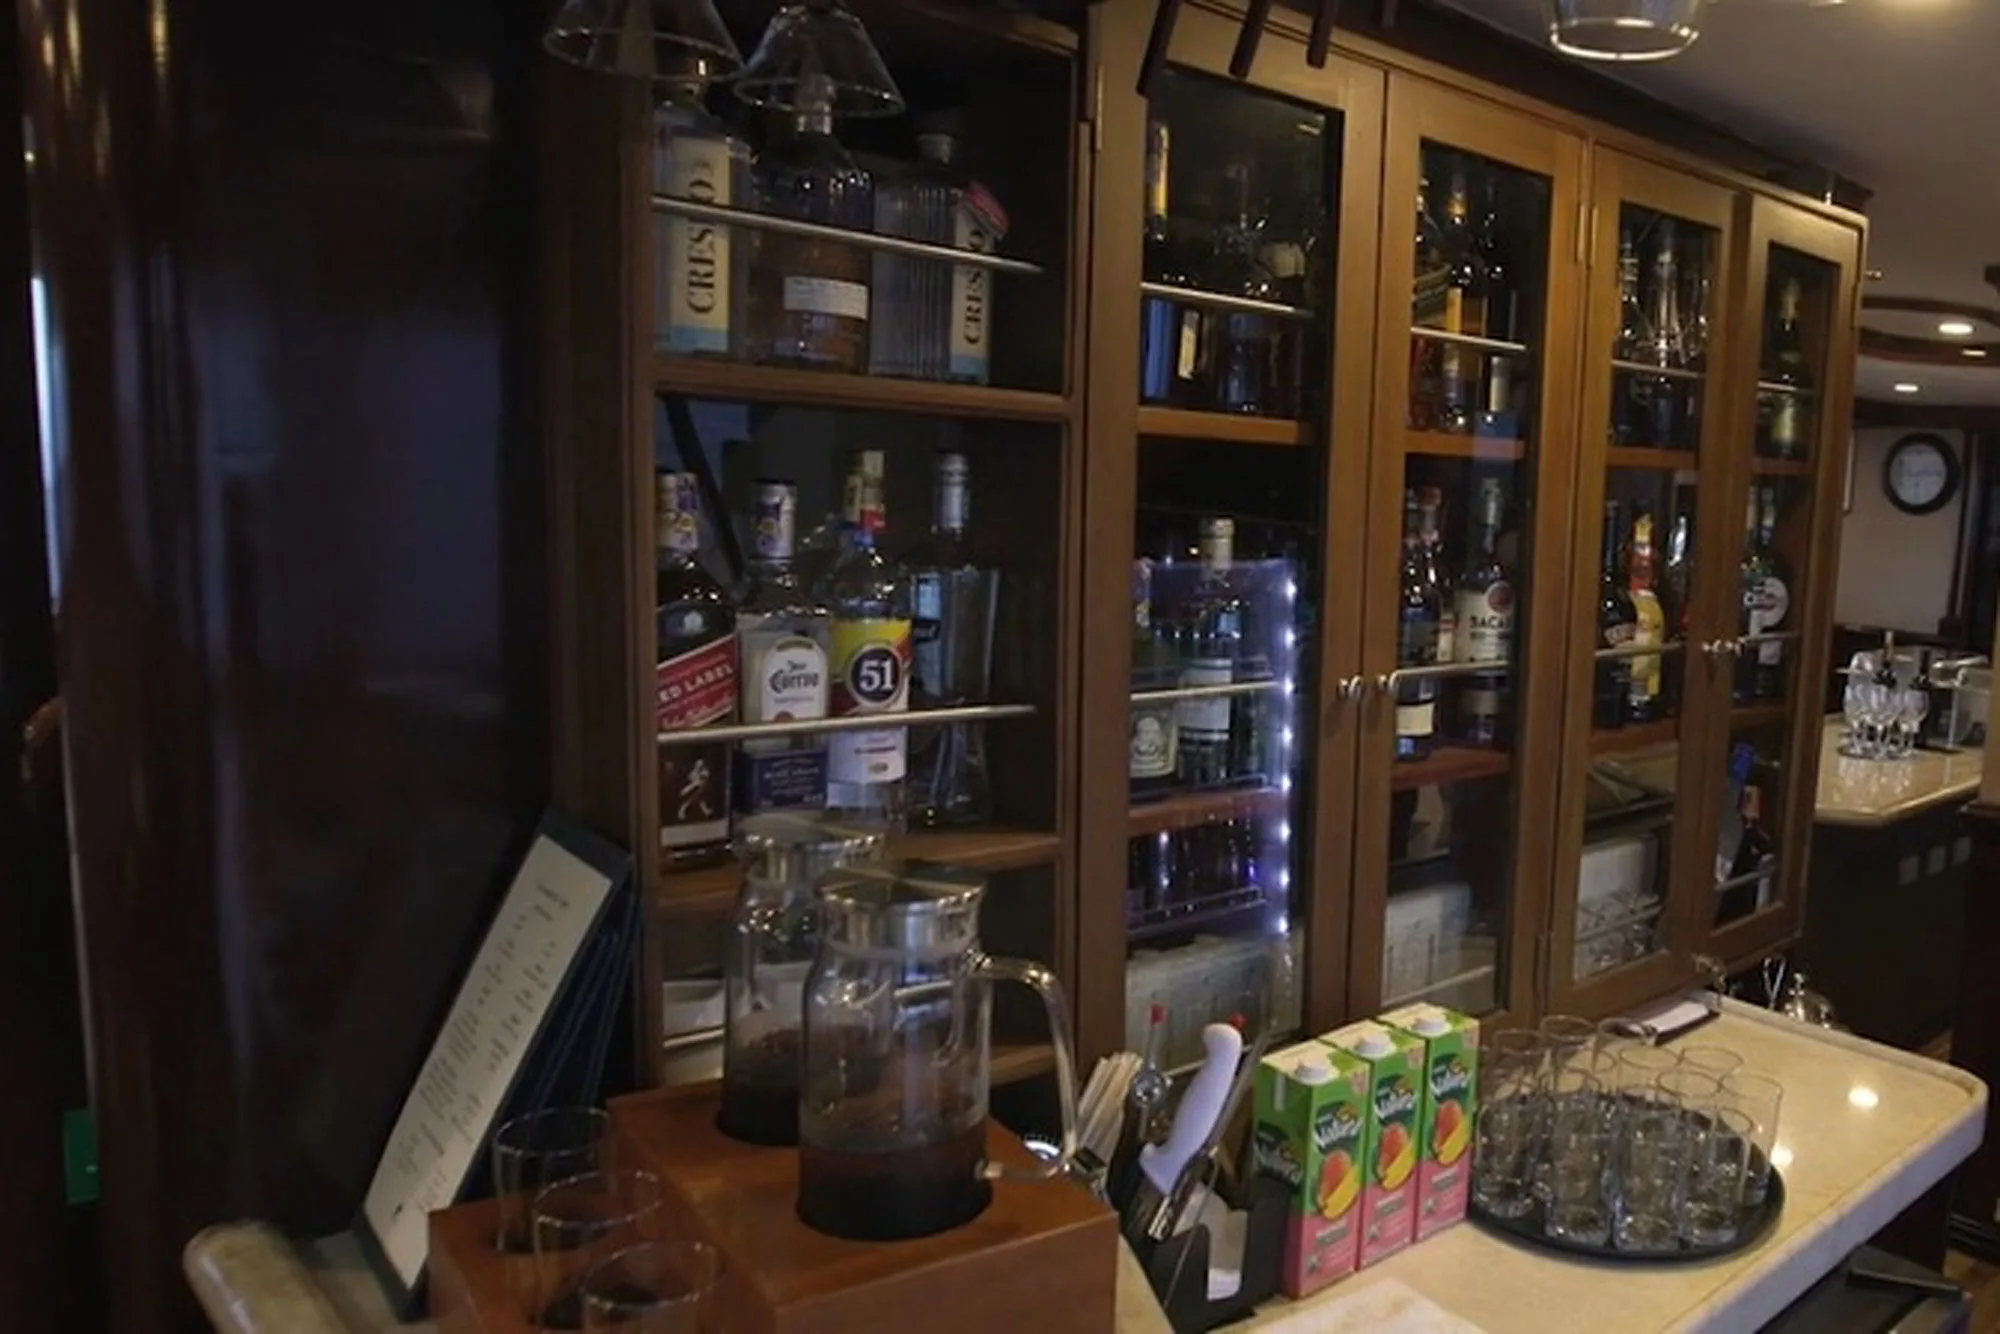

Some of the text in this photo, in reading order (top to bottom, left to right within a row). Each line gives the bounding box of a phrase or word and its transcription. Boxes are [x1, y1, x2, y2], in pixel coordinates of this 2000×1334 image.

[686, 178, 716, 314] CRESO
[963, 228, 984, 346] CRESO
[659, 685, 682, 703] ED
[859, 658, 894, 693] 51
